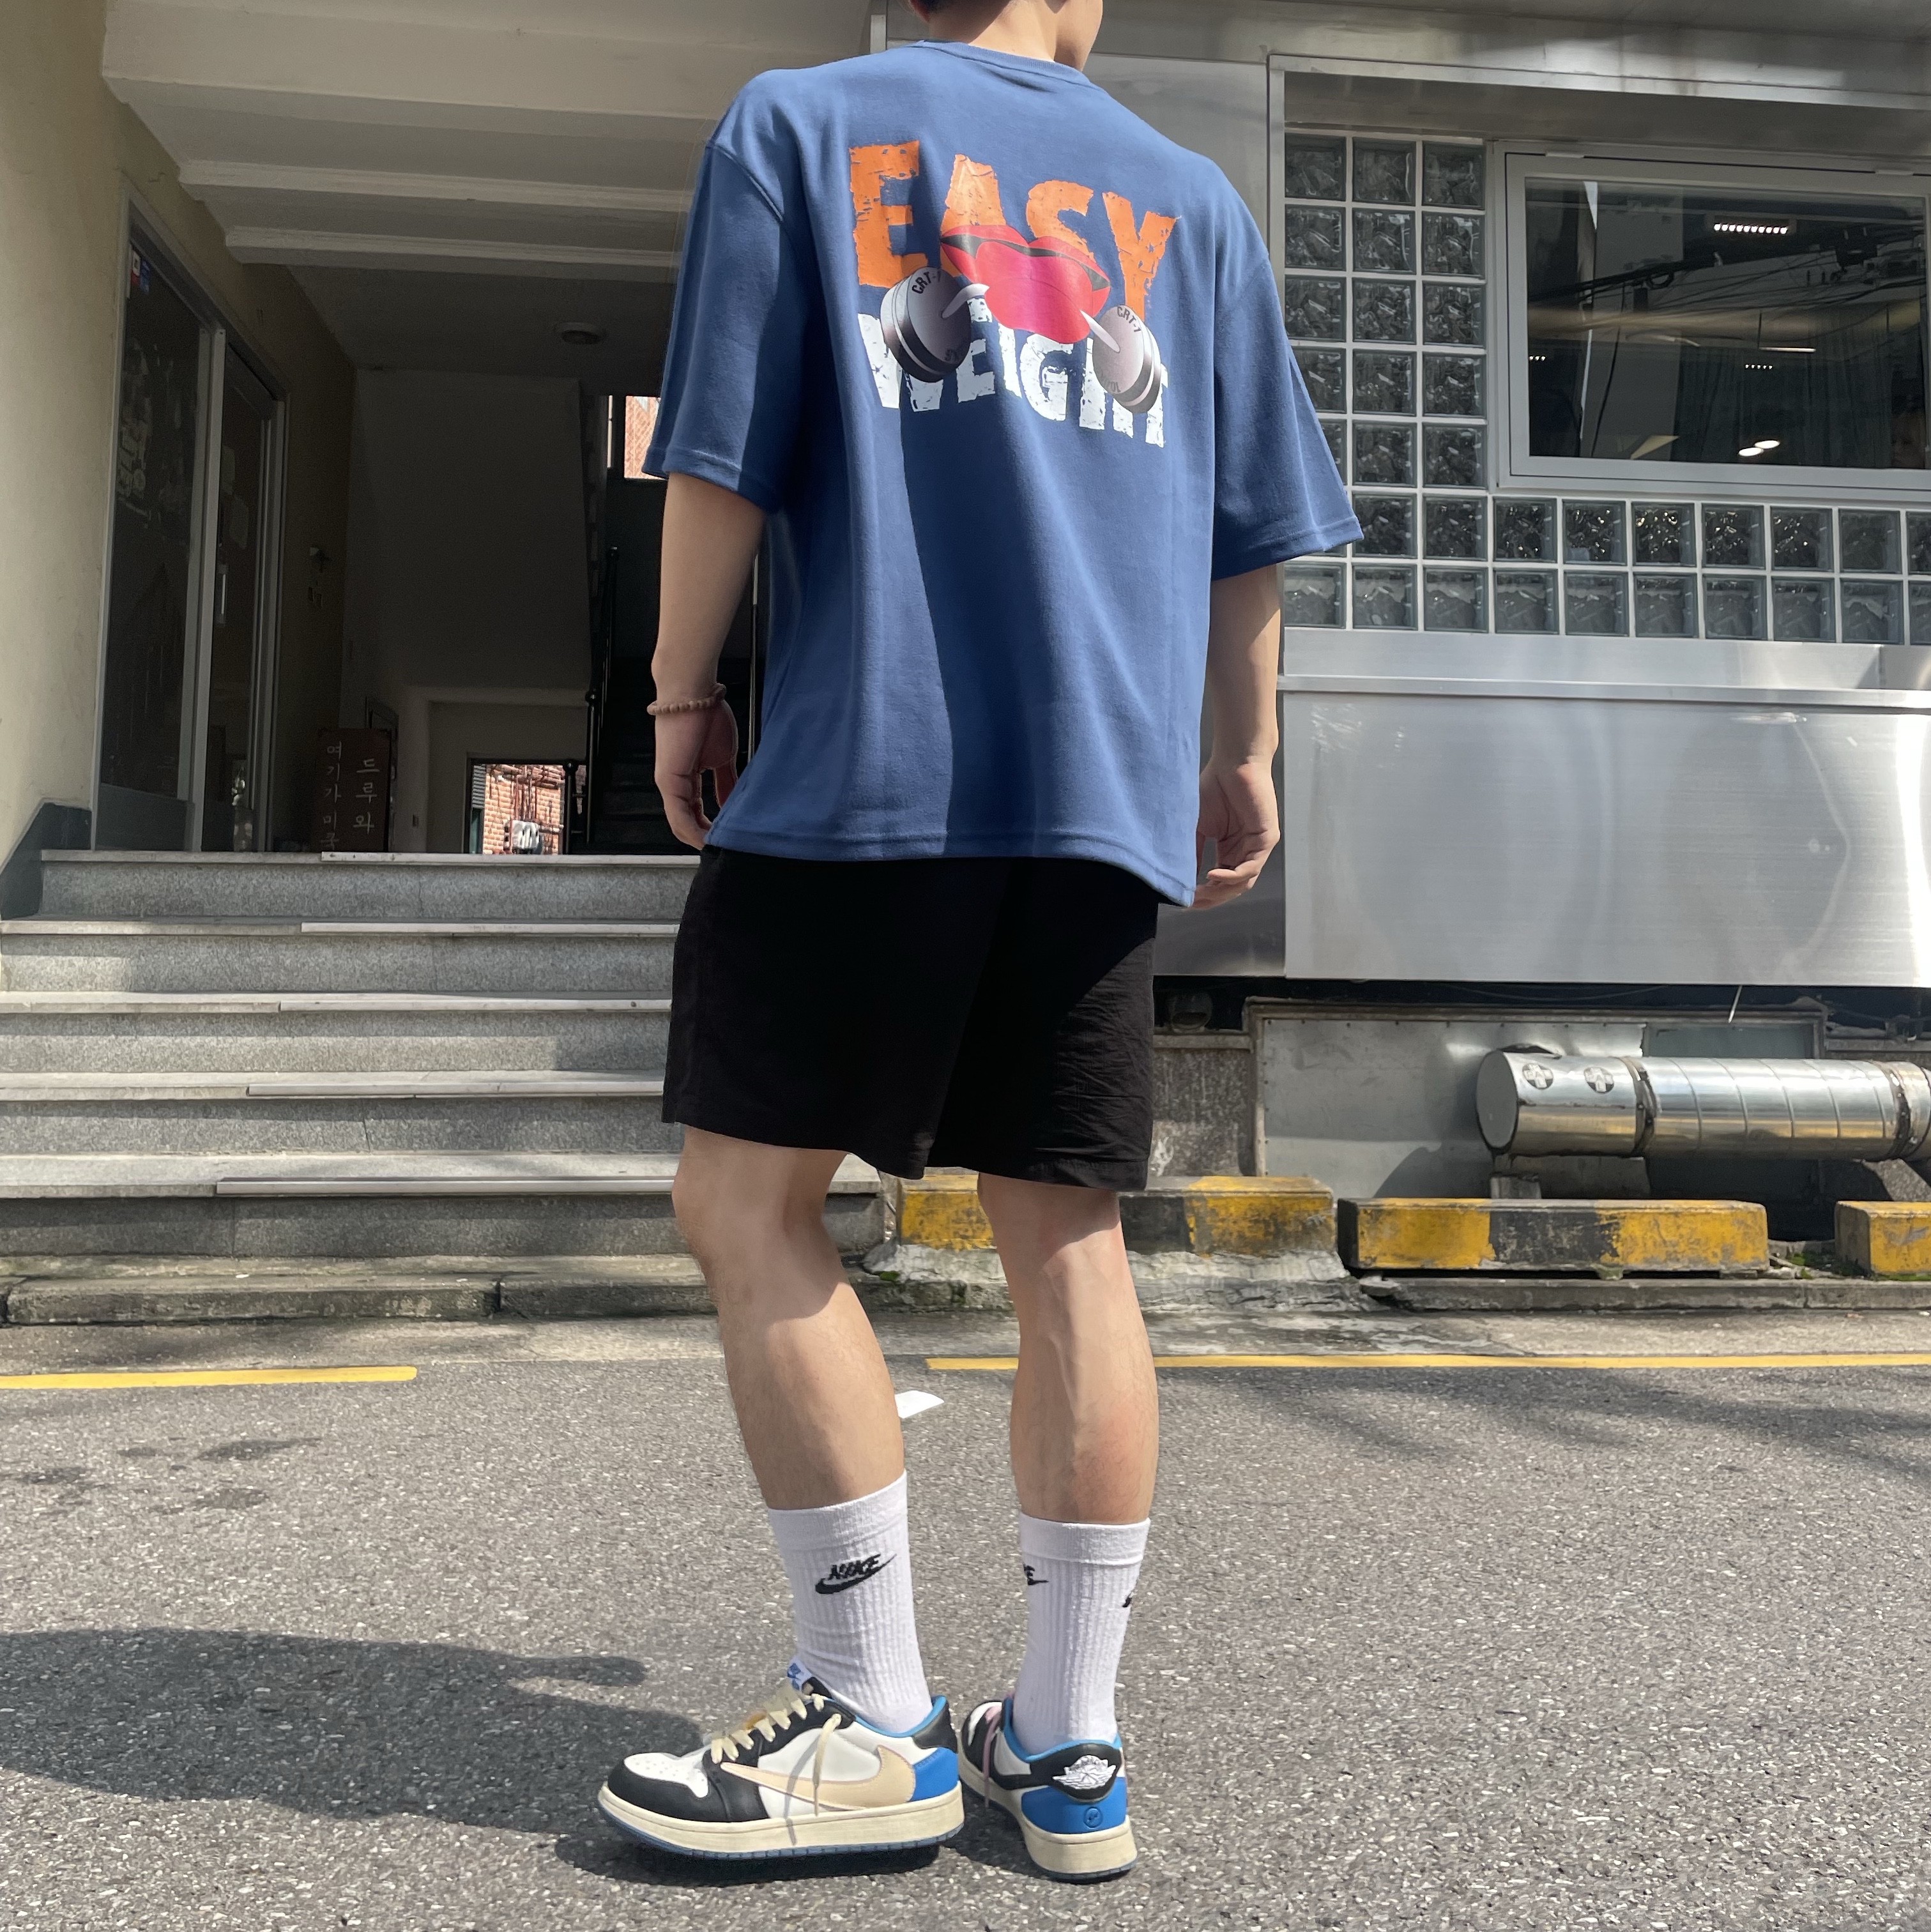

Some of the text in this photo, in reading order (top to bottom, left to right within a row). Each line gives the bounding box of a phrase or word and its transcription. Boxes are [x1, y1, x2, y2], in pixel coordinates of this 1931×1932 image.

[850, 140, 1179, 321] EASY
[912, 270, 941, 294] CRT-1
[1117, 306, 1141, 332] CRT-1
[353, 758, 380, 835] 드루와
